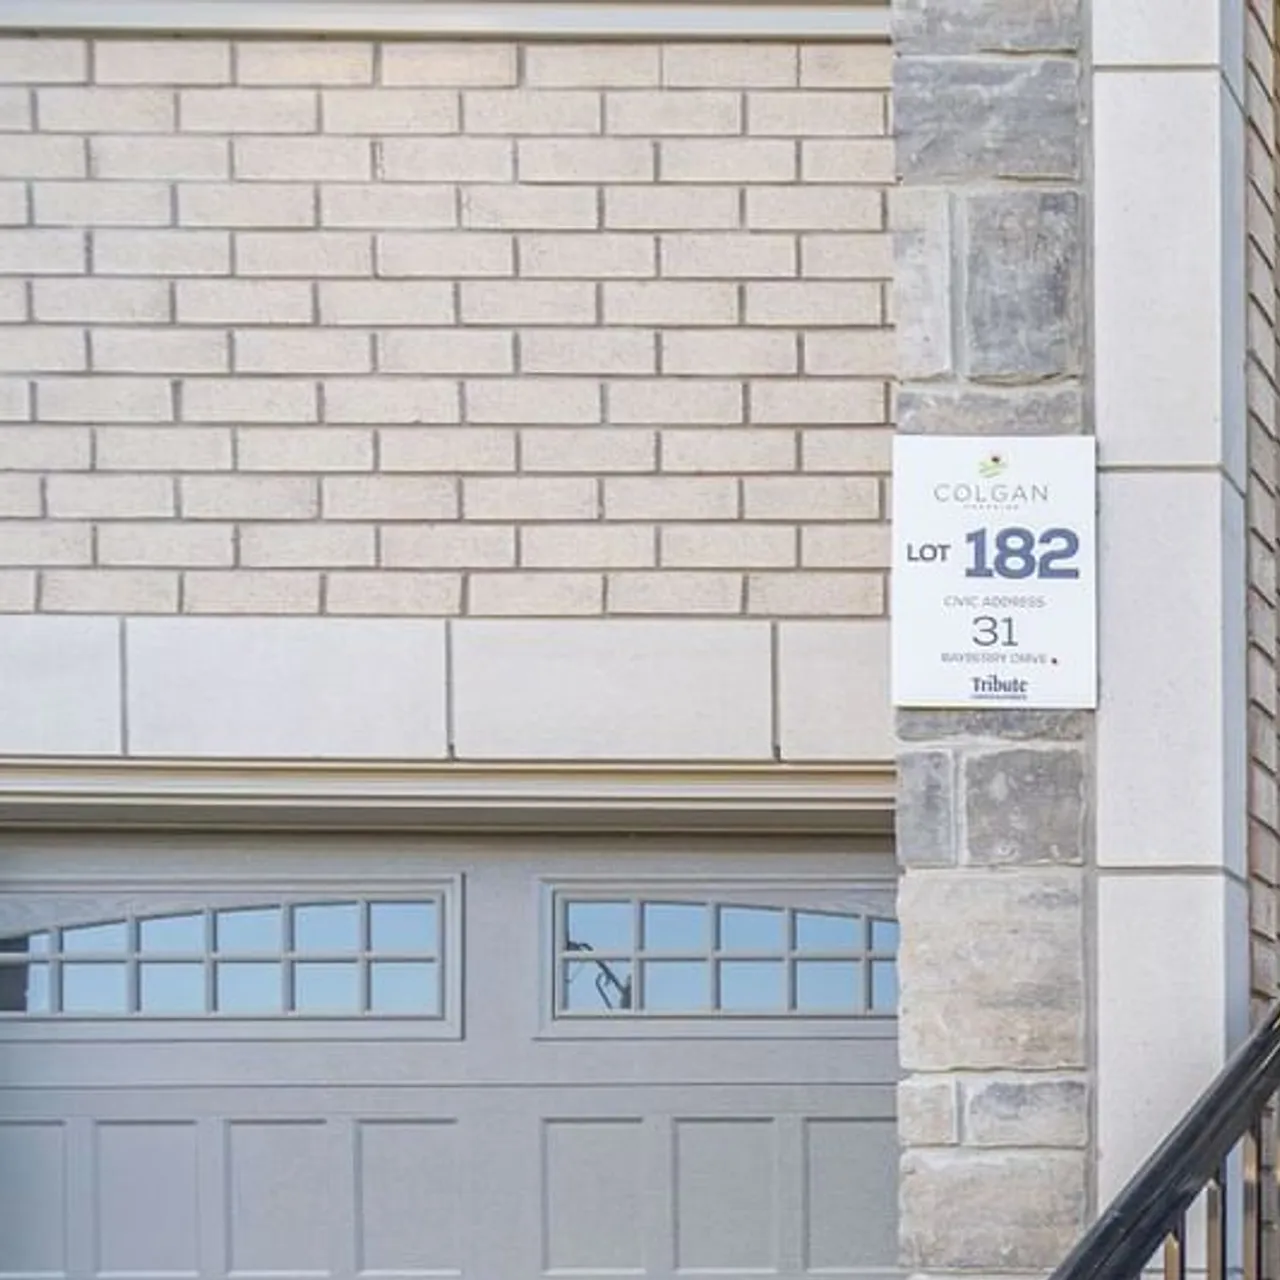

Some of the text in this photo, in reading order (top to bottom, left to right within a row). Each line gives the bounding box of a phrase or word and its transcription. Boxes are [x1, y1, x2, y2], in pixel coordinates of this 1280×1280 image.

[934, 483, 1048, 502] COLGAN
[907, 526, 1080, 579] LOT 182
[982, 595, 1047, 608] ADDRESS
[972, 616, 1018, 647] 31
[970, 674, 1028, 692] Tribute
